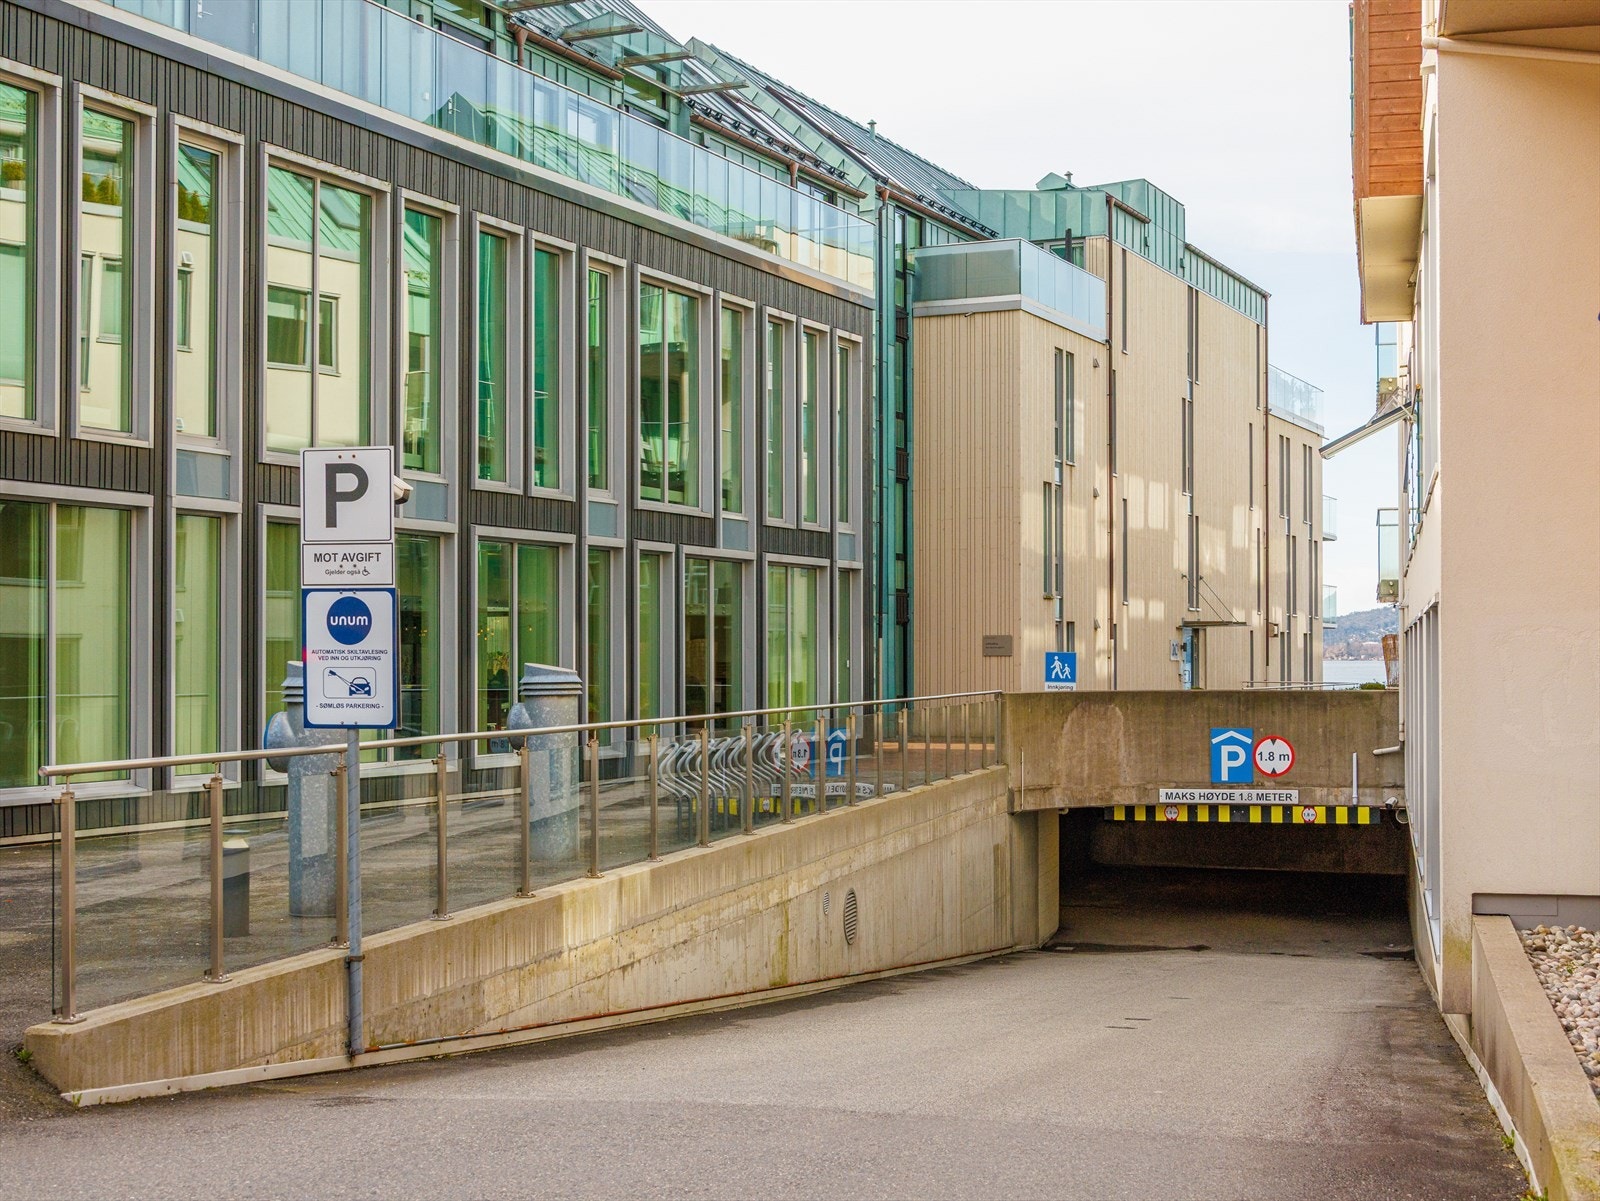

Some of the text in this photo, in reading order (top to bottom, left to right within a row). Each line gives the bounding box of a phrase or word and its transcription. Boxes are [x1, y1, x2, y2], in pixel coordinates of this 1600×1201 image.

[325, 463, 369, 528] P
[313, 552, 382, 562] MOT AVGIFT
[325, 568, 346, 576] Gjelder
[330, 616, 368, 626] unum
[1258, 752, 1290, 761] 1.8 m
[1221, 745, 1246, 781] P
[1165, 792, 1293, 801] MAKS HØYDE 1.8 METER
